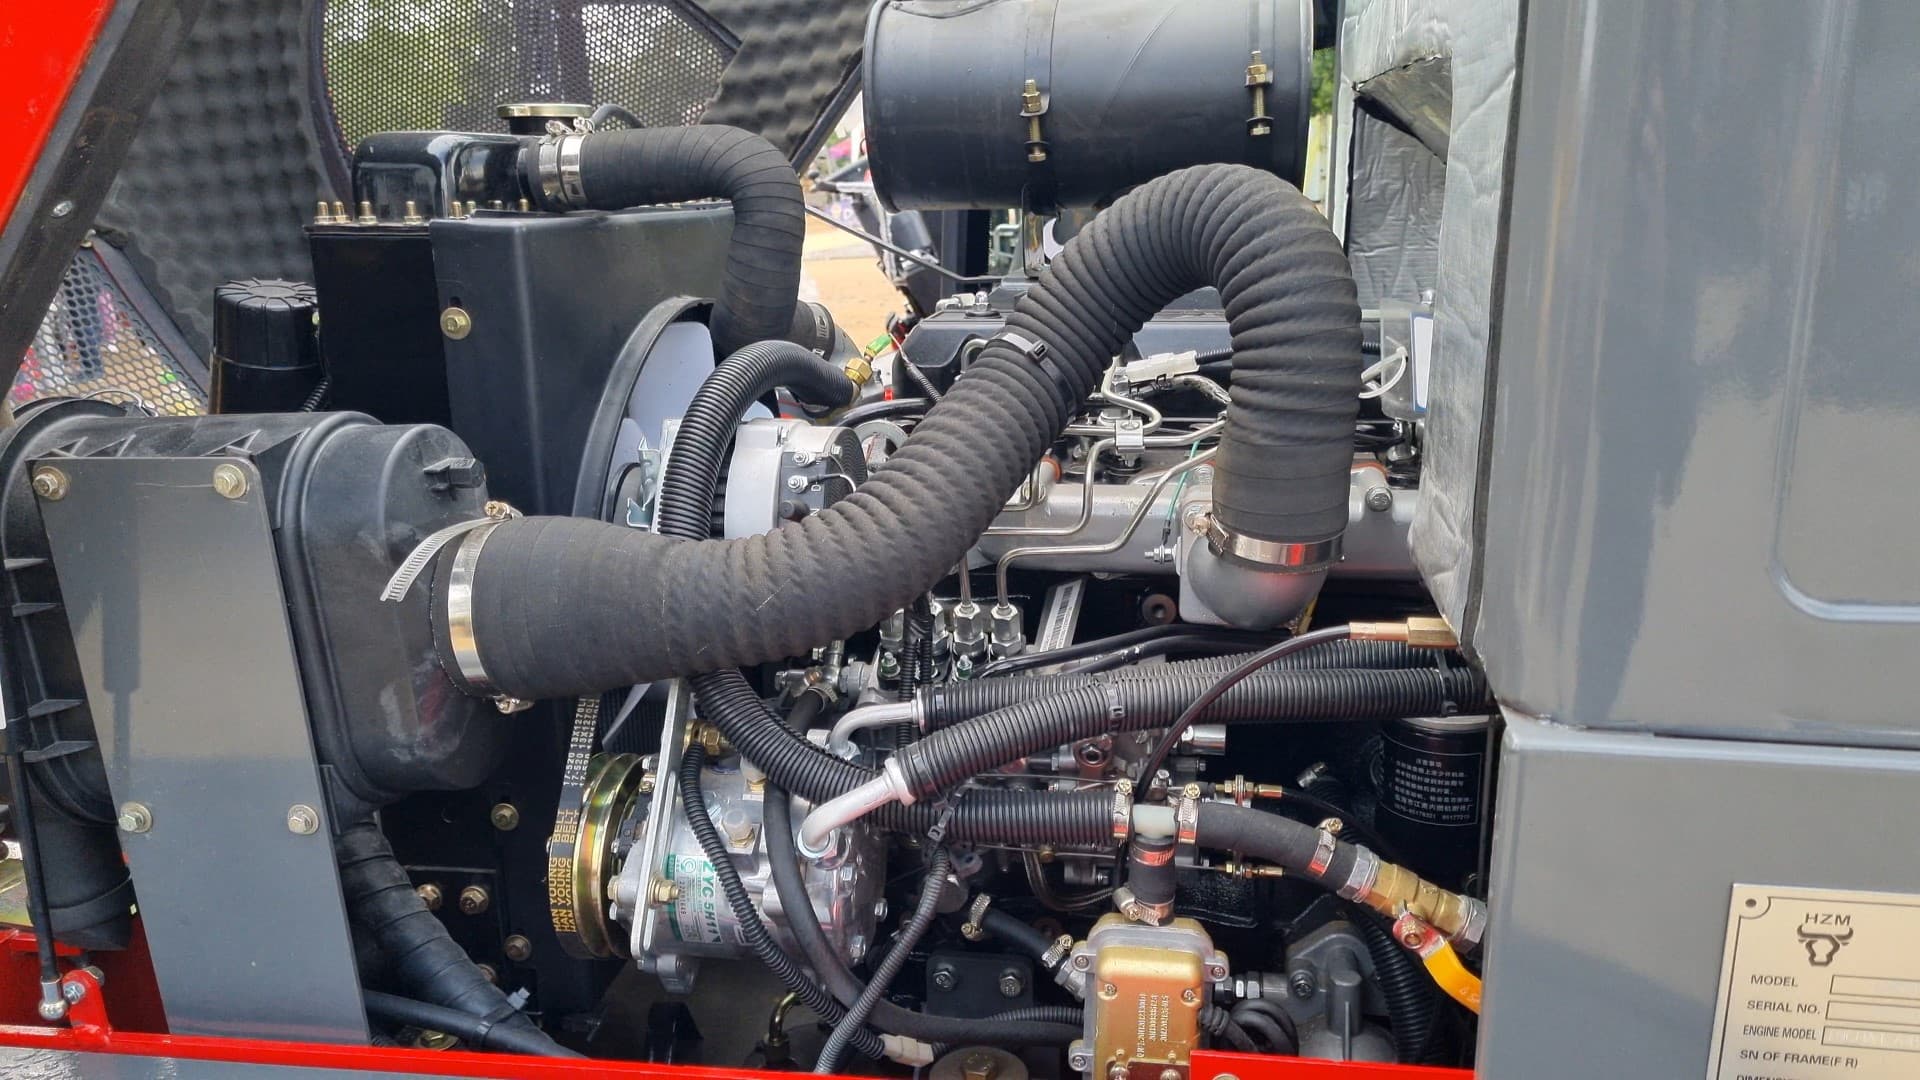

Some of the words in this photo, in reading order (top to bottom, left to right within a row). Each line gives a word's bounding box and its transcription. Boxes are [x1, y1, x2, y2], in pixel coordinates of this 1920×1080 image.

[563, 752, 575, 787] 17-520
[571, 753, 584, 787] 17-520
[552, 808, 565, 843] BELT
[561, 808, 574, 844] BELT
[548, 857, 558, 905] YOUNG
[557, 857, 567, 906] YOUNG
[551, 909, 561, 932] HAN
[559, 909, 569, 932] HAN
[1804, 912, 1852, 926] HZM
[1750, 974, 1799, 988] MODEL
[1746, 1000, 1793, 1013] SERIAL
[1796, 1003, 1821, 1014] NO.
[1742, 1024, 1780, 1038] ENGINE
[1782, 1026, 1817, 1040] MODEL
[1739, 1049, 1759, 1060] SN
[1762, 1051, 1781, 1061] OF
